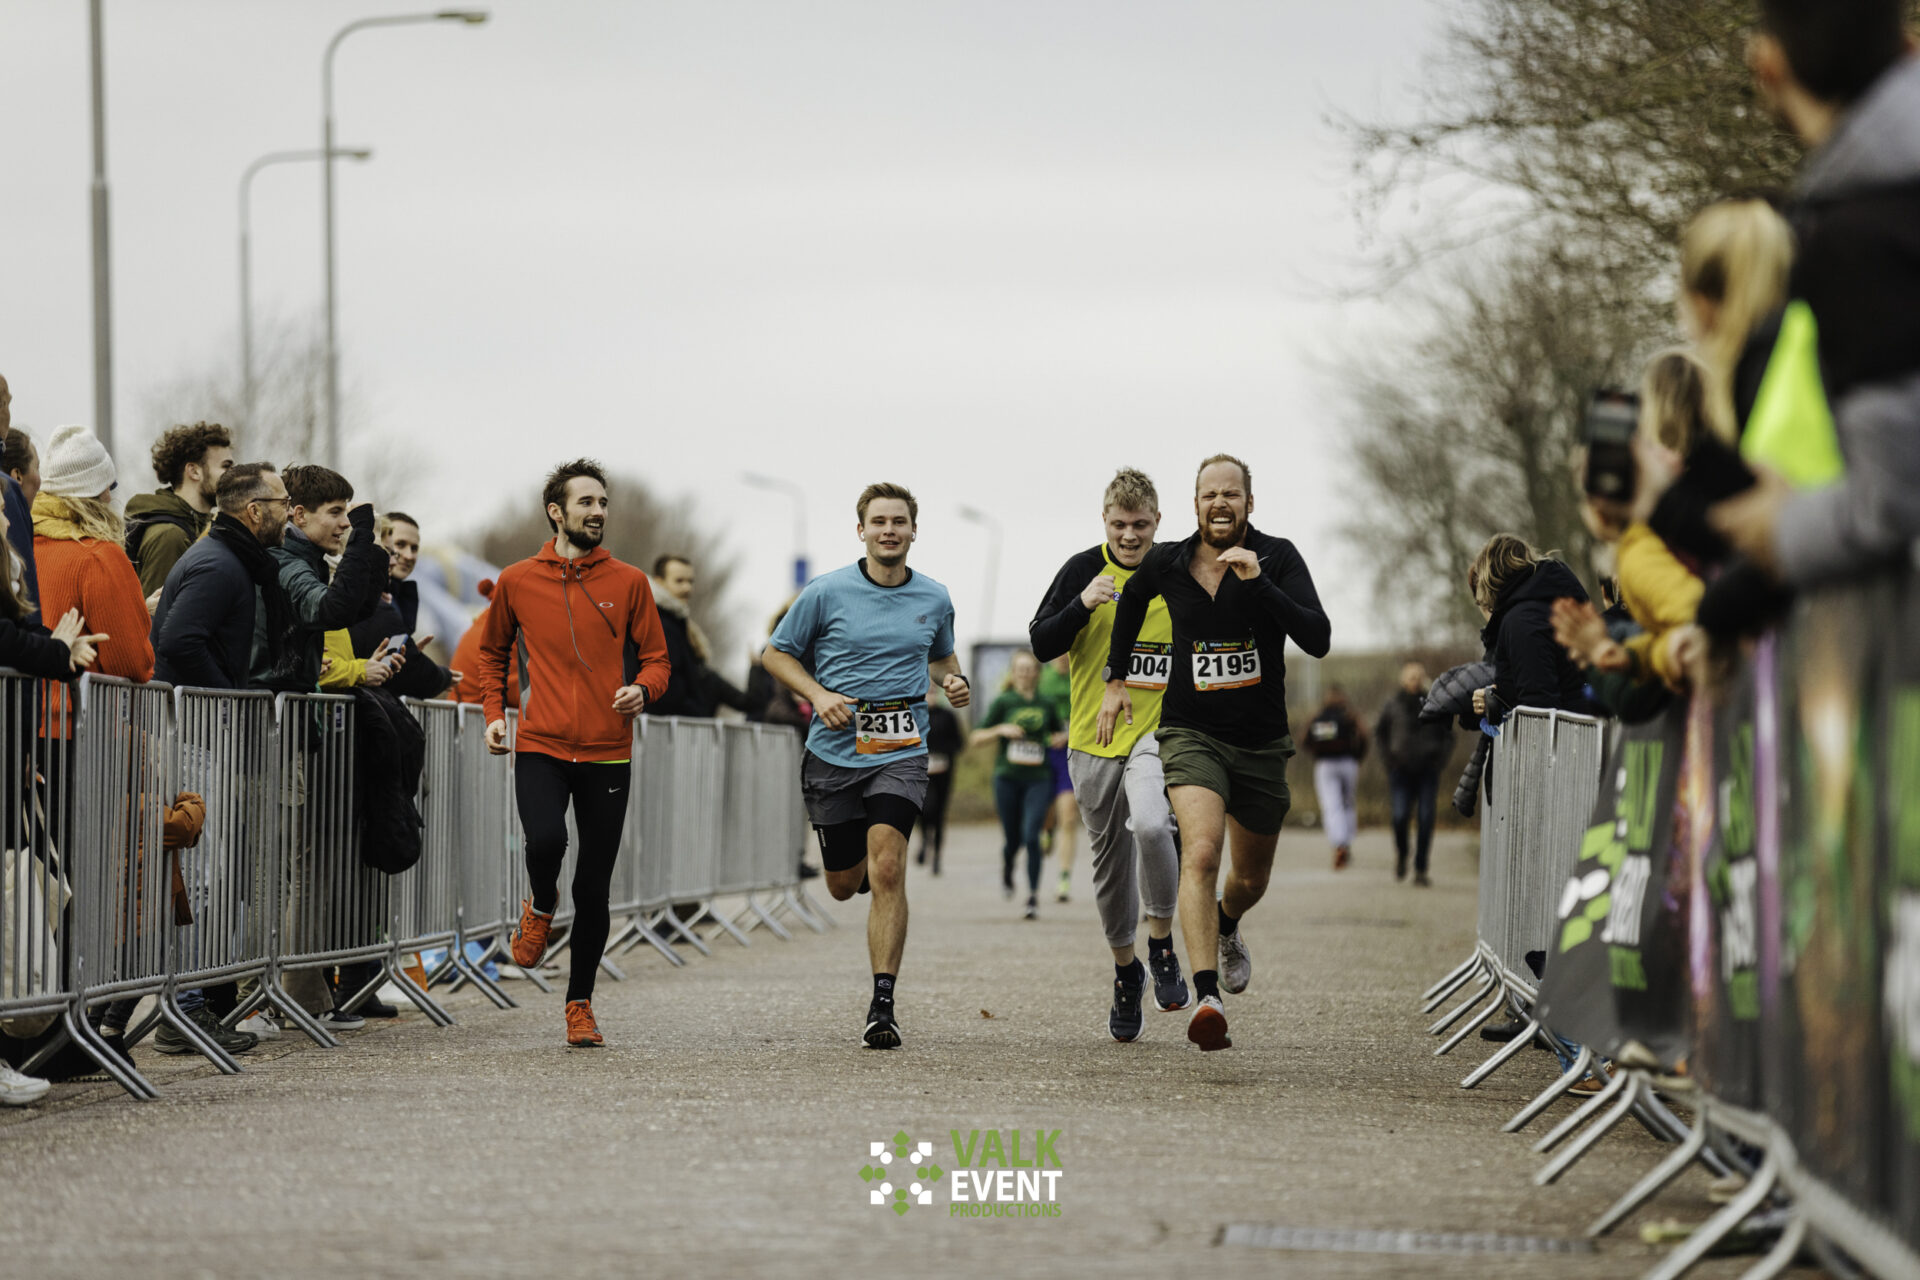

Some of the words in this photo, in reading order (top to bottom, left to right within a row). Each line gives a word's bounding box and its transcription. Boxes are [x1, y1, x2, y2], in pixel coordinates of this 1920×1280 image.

[1129, 654, 1168, 677] 004
[1197, 652, 1257, 677] 2195
[860, 712, 915, 734] 2313
